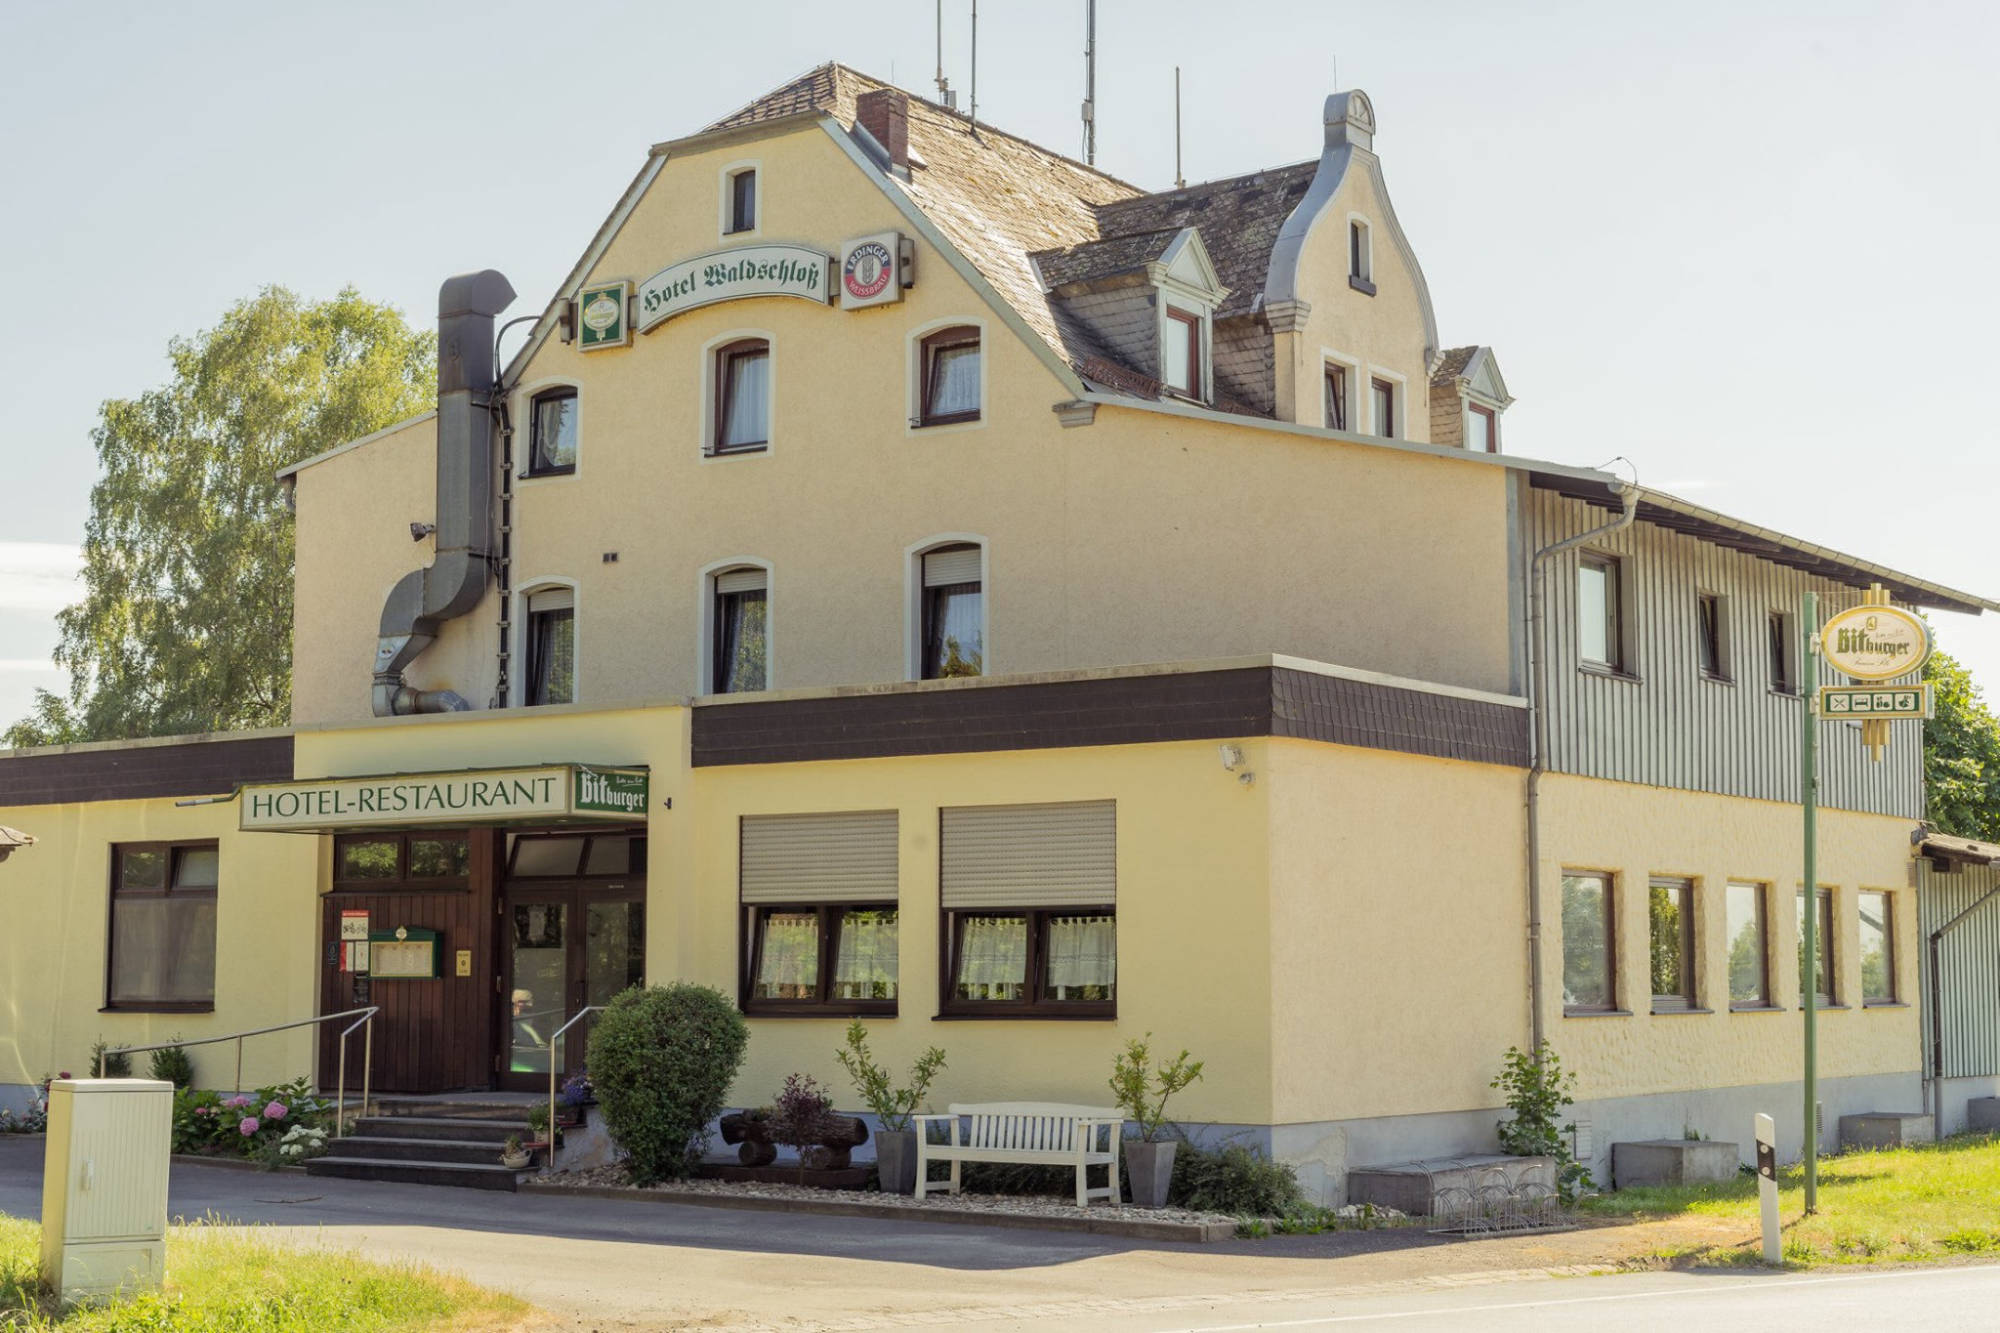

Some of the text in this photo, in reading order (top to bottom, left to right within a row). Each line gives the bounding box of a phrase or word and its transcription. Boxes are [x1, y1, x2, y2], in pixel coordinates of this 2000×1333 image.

[847, 245, 889, 270] ERDINGER
[644, 258, 819, 312] Hotel Waldschloß
[1836, 627, 1909, 659] Bitburger
[253, 777, 557, 818] HOTEL-RESTAURANT
[580, 772, 645, 812] Bitburger
